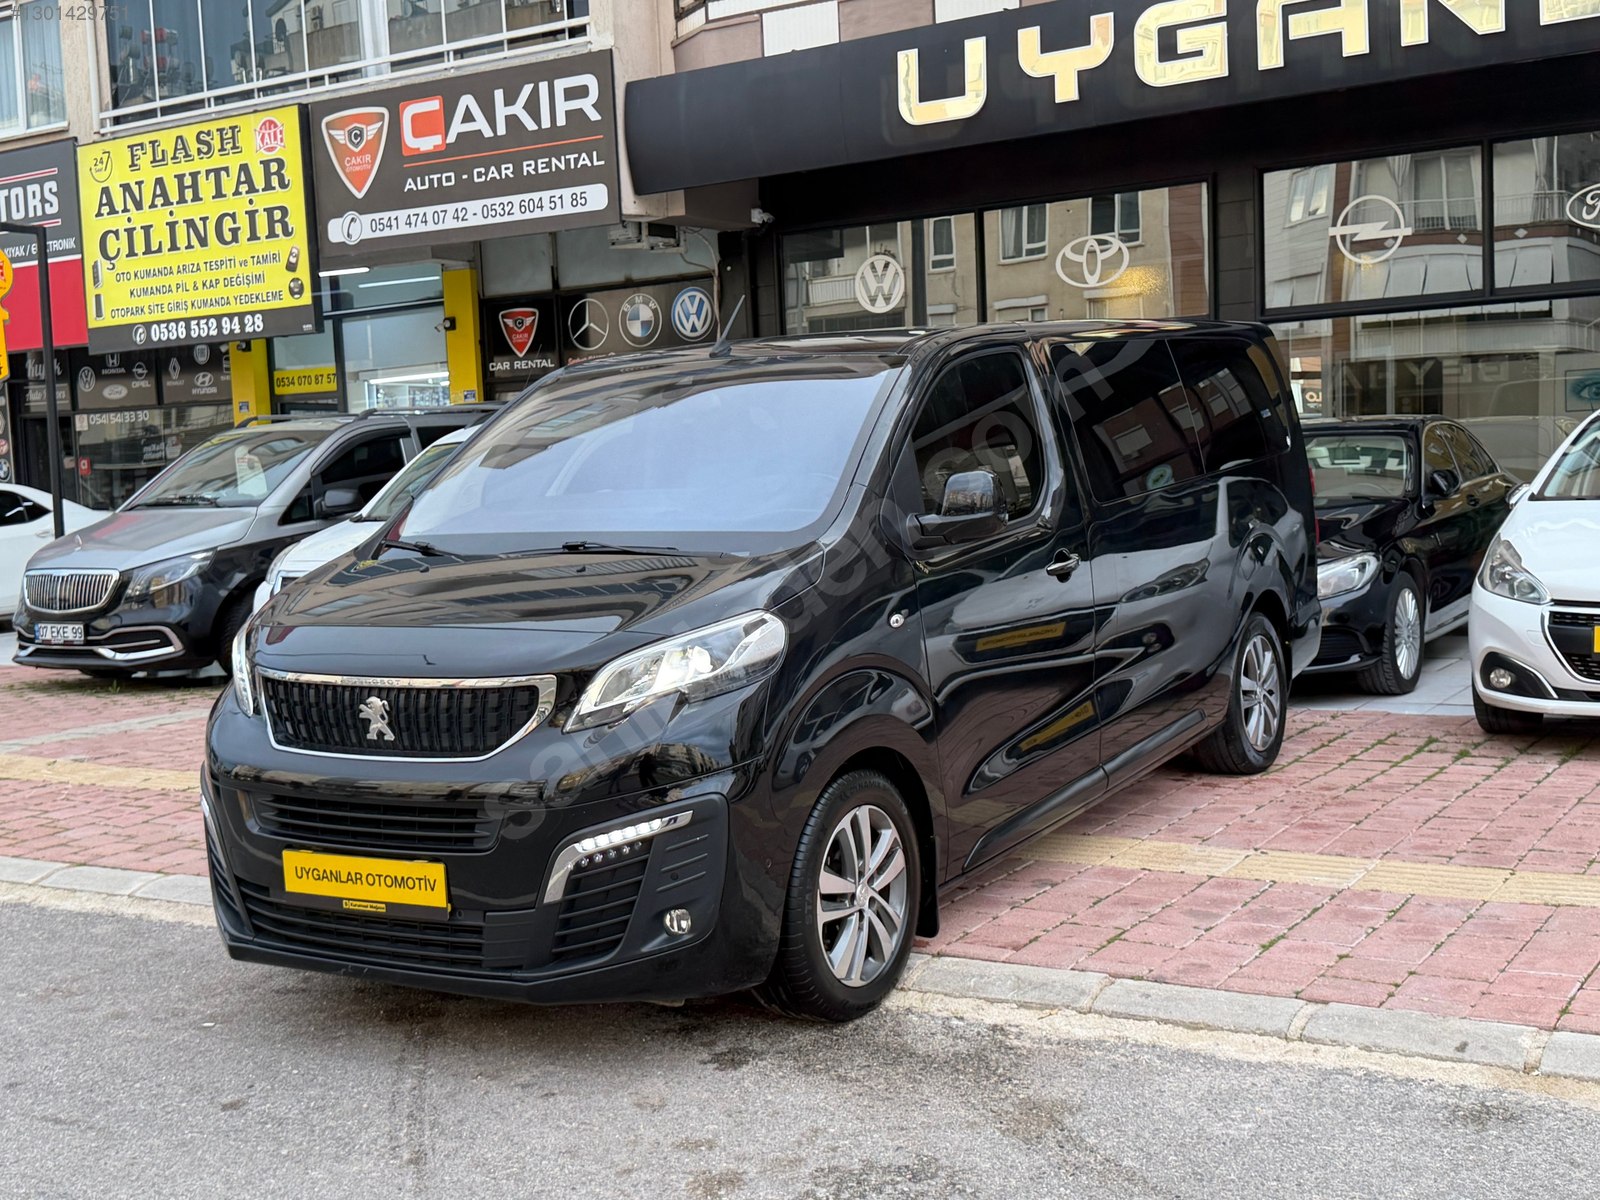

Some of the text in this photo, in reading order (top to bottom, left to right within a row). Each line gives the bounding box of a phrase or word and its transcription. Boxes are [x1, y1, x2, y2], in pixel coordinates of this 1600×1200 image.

[897, 0, 1600, 126] UYGAN
[402, 73, 602, 151] ÇAKIR
[127, 125, 242, 172] FLASH
[257, 129, 285, 148] KALE
[404, 171, 455, 192] AUTO
[473, 164, 514, 183] CAR
[522, 150, 605, 176] RENTAL
[95, 157, 290, 218] ANAHTAR
[370, 215, 400, 233] 0541
[405, 212, 428, 229] 474
[432, 210, 448, 226] 07
[452, 207, 469, 223] 42
[481, 201, 515, 220] 0532
[519, 197, 544, 215] 604
[549, 194, 565, 211] 51
[570, 191, 587, 208] 85
[99, 198, 294, 270] ÇİLİNGİR
[115, 250, 281, 283] OTO KUMANDA ARIZA TESPİTİ ve TAMİRİ
[130, 271, 266, 299] KUMANDA PİL & KAP DEĞİŞİMİ
[110, 290, 284, 319] OTOPARK SİTE GİRİŞ KUMANDA YEDEKLEME
[151, 313, 264, 342] 0536 552 94 28
[102, 367, 126, 375] HONDA
[489, 361, 510, 371] CAR
[514, 358, 555, 370] RENTAL
[276, 373, 336, 388] 0534 070 87 57
[51, 626, 69, 638] EKE
[72, 627, 83, 639] 99
[295, 866, 436, 892] UYGANLAR OTOMOTİV
